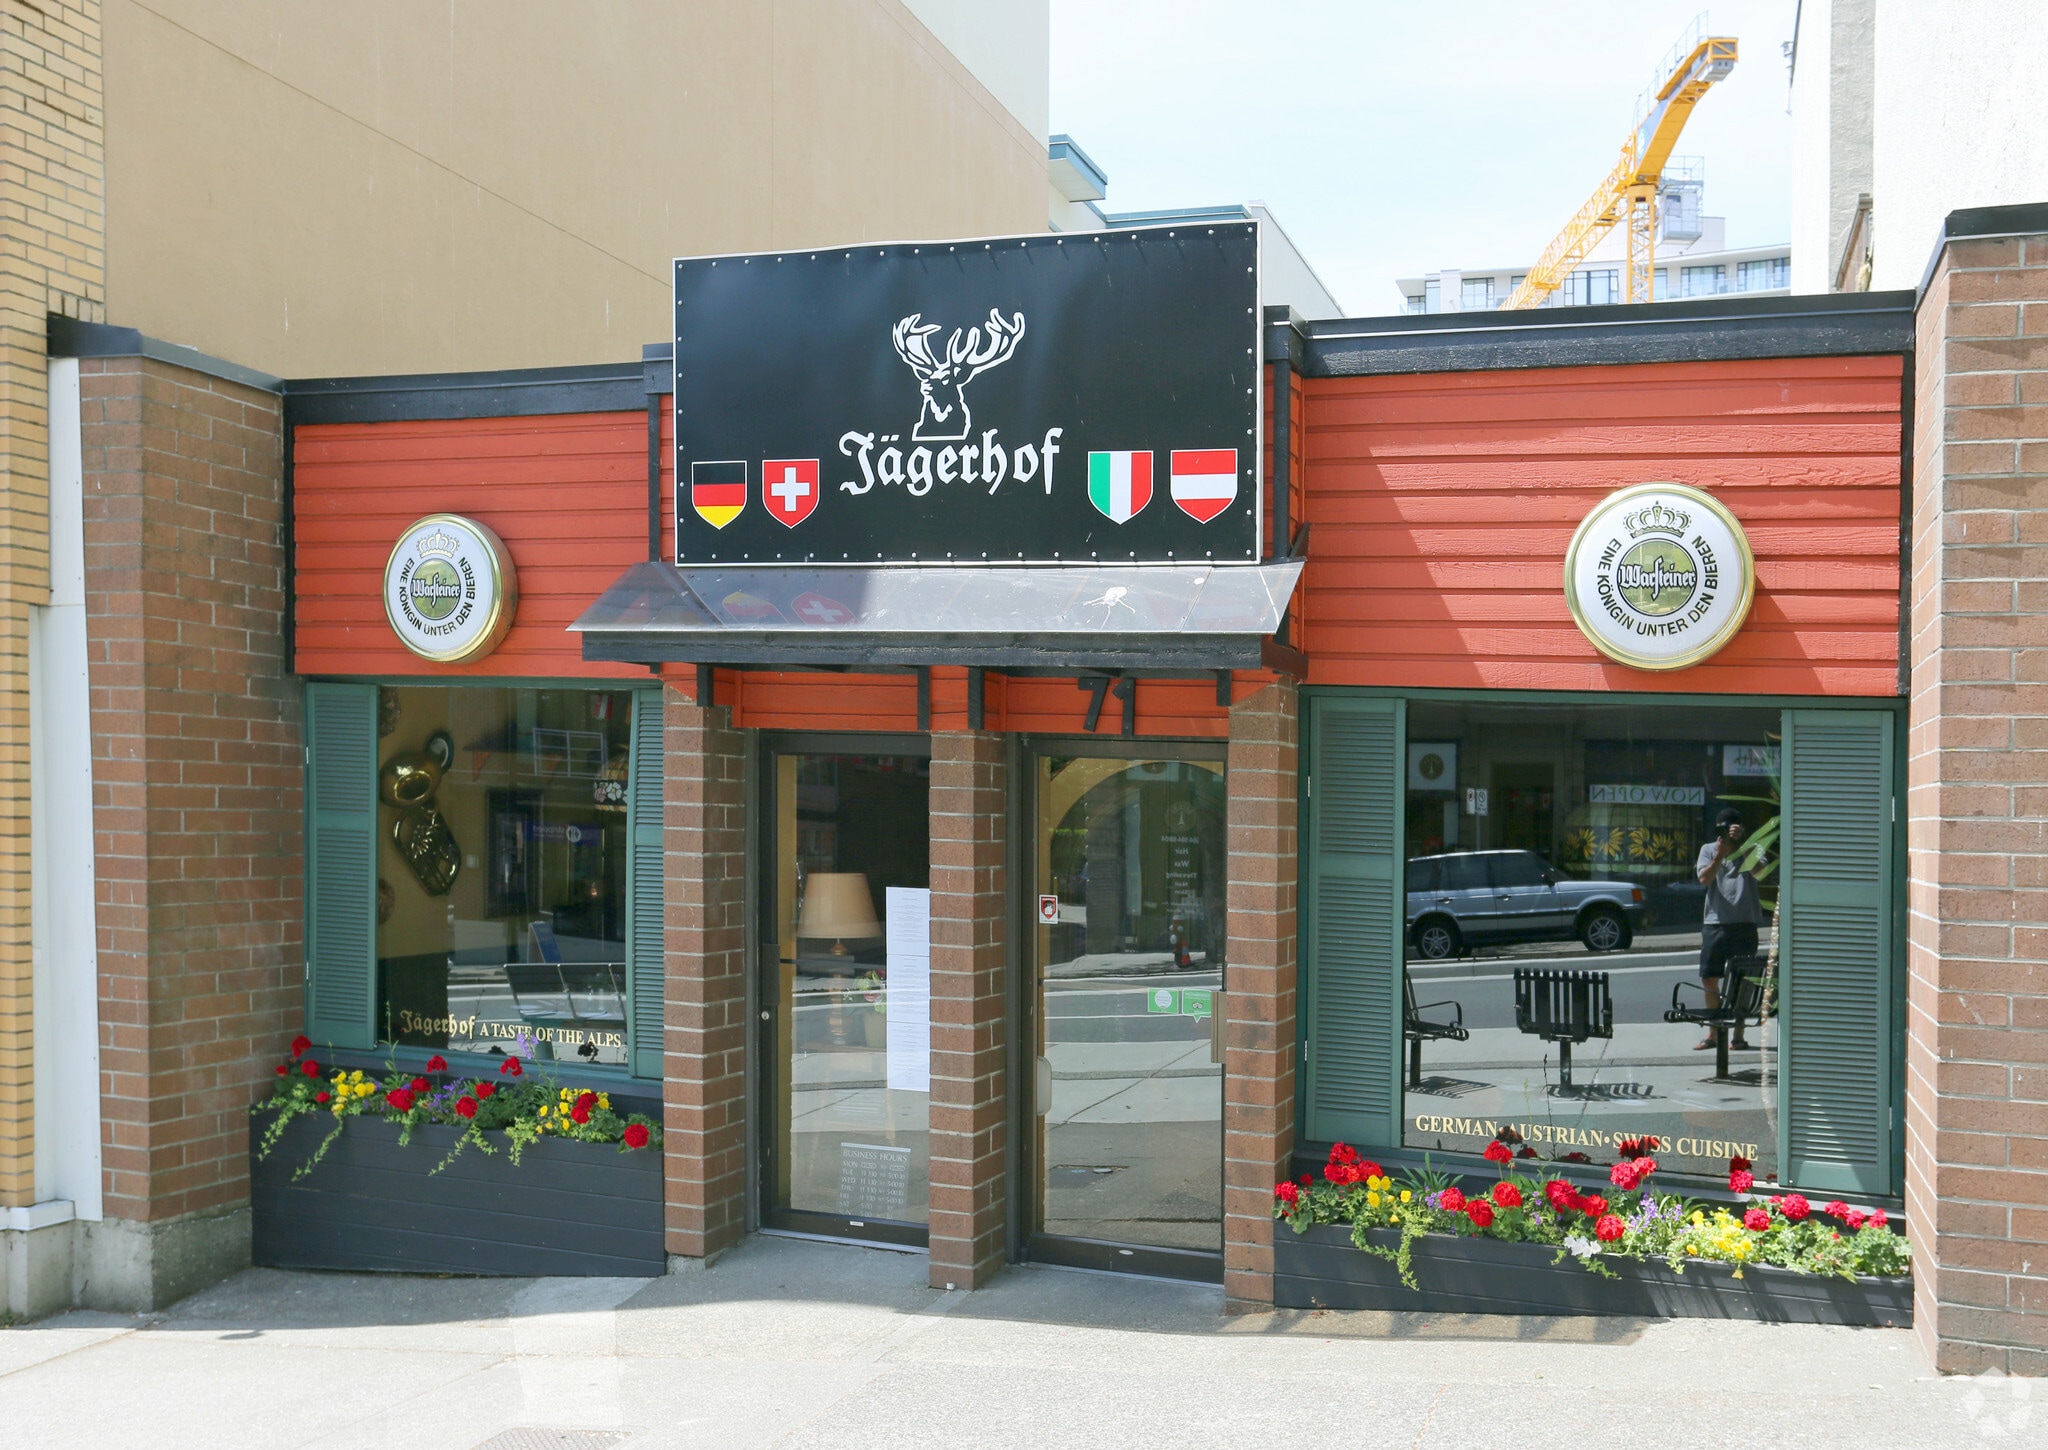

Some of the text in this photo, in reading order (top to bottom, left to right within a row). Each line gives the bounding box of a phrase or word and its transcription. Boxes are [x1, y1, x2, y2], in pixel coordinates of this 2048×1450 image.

[838, 427, 1064, 496] Jägerhof
[399, 557, 476, 636] EINE KÖNIGIN UNTER DEN BIEREN
[1597, 535, 1718, 637] EINE KÖNIGIN UNTER DEN BIEREN
[1618, 555, 1697, 602] Warsteiner
[1078, 677, 1136, 736] 71
[400, 1009, 622, 1048] Jägerhof A TASTE OF THE ALPS
[843, 1150, 907, 1162] BUSINESS HOURS
[1415, 1114, 1759, 1161] GERMAN AUSTRIAN SWISS CUISINE
